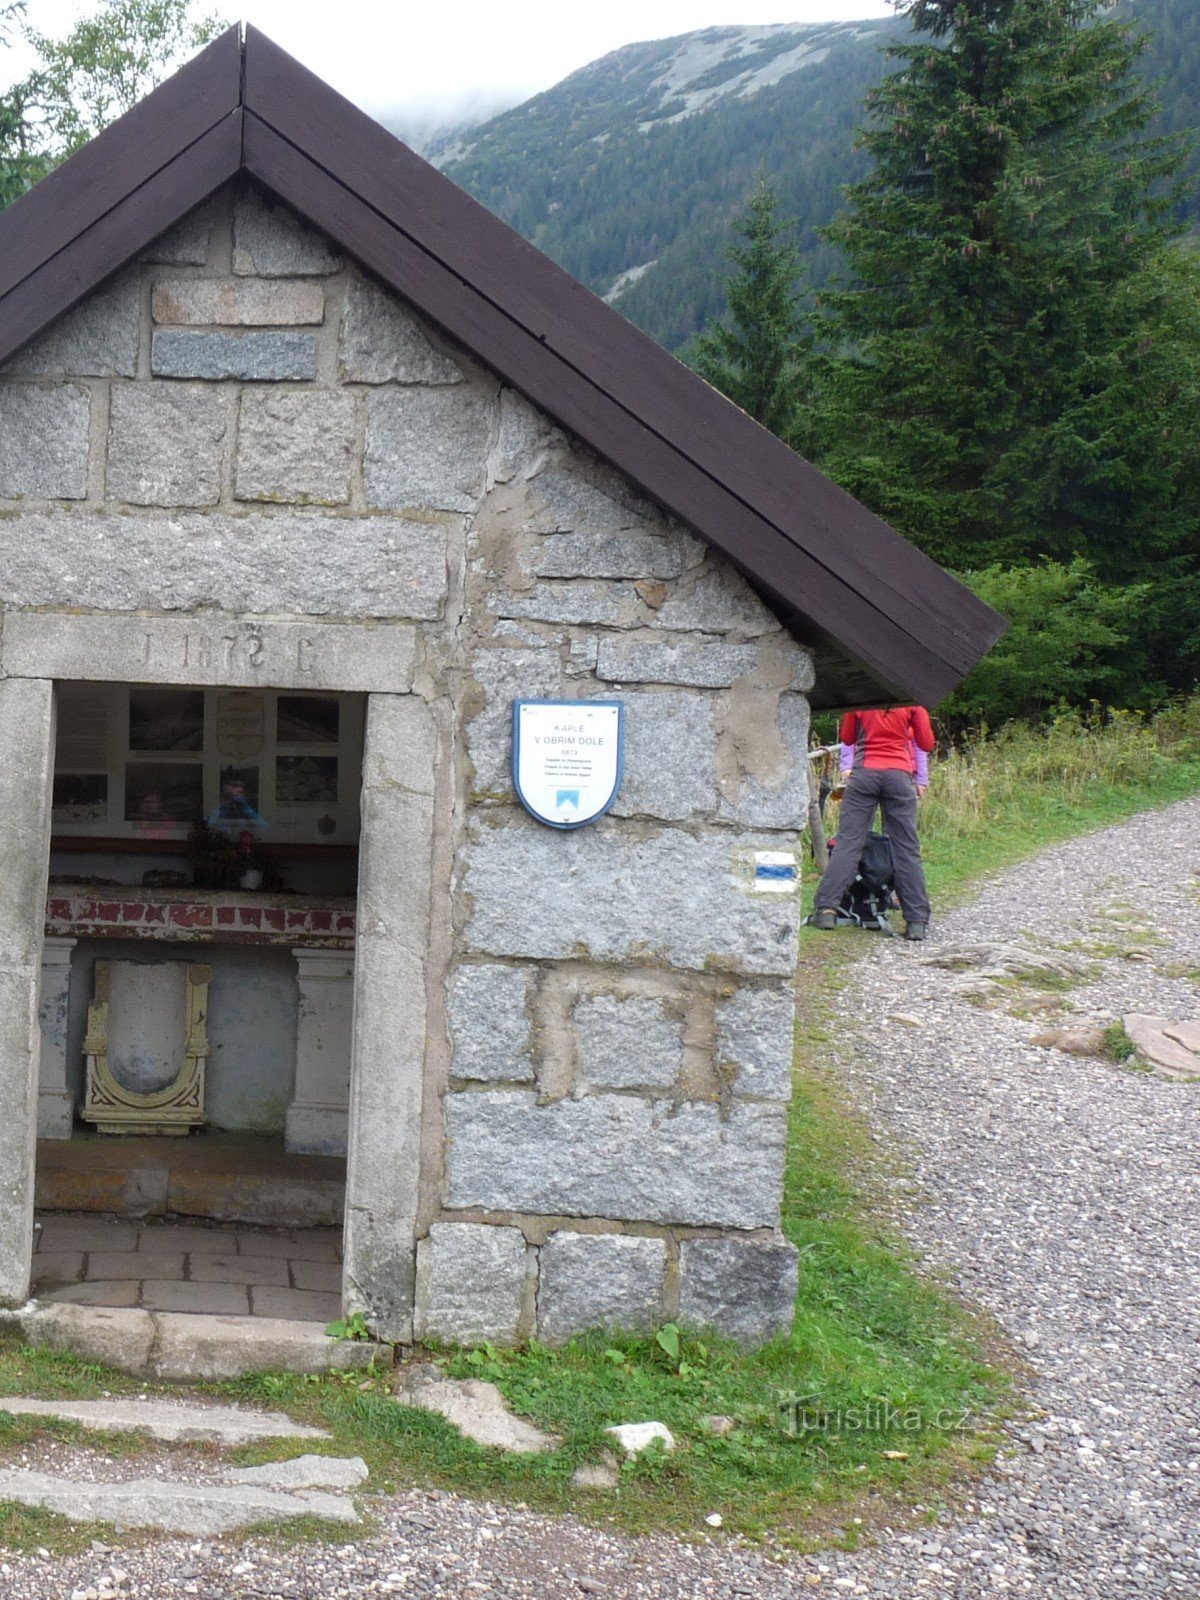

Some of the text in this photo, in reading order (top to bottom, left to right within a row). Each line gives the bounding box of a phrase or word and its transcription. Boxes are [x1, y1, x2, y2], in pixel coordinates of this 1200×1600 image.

[554, 724, 585, 733] KAPLE
[534, 735, 540, 744] V
[578, 737, 604, 746] DOLE
